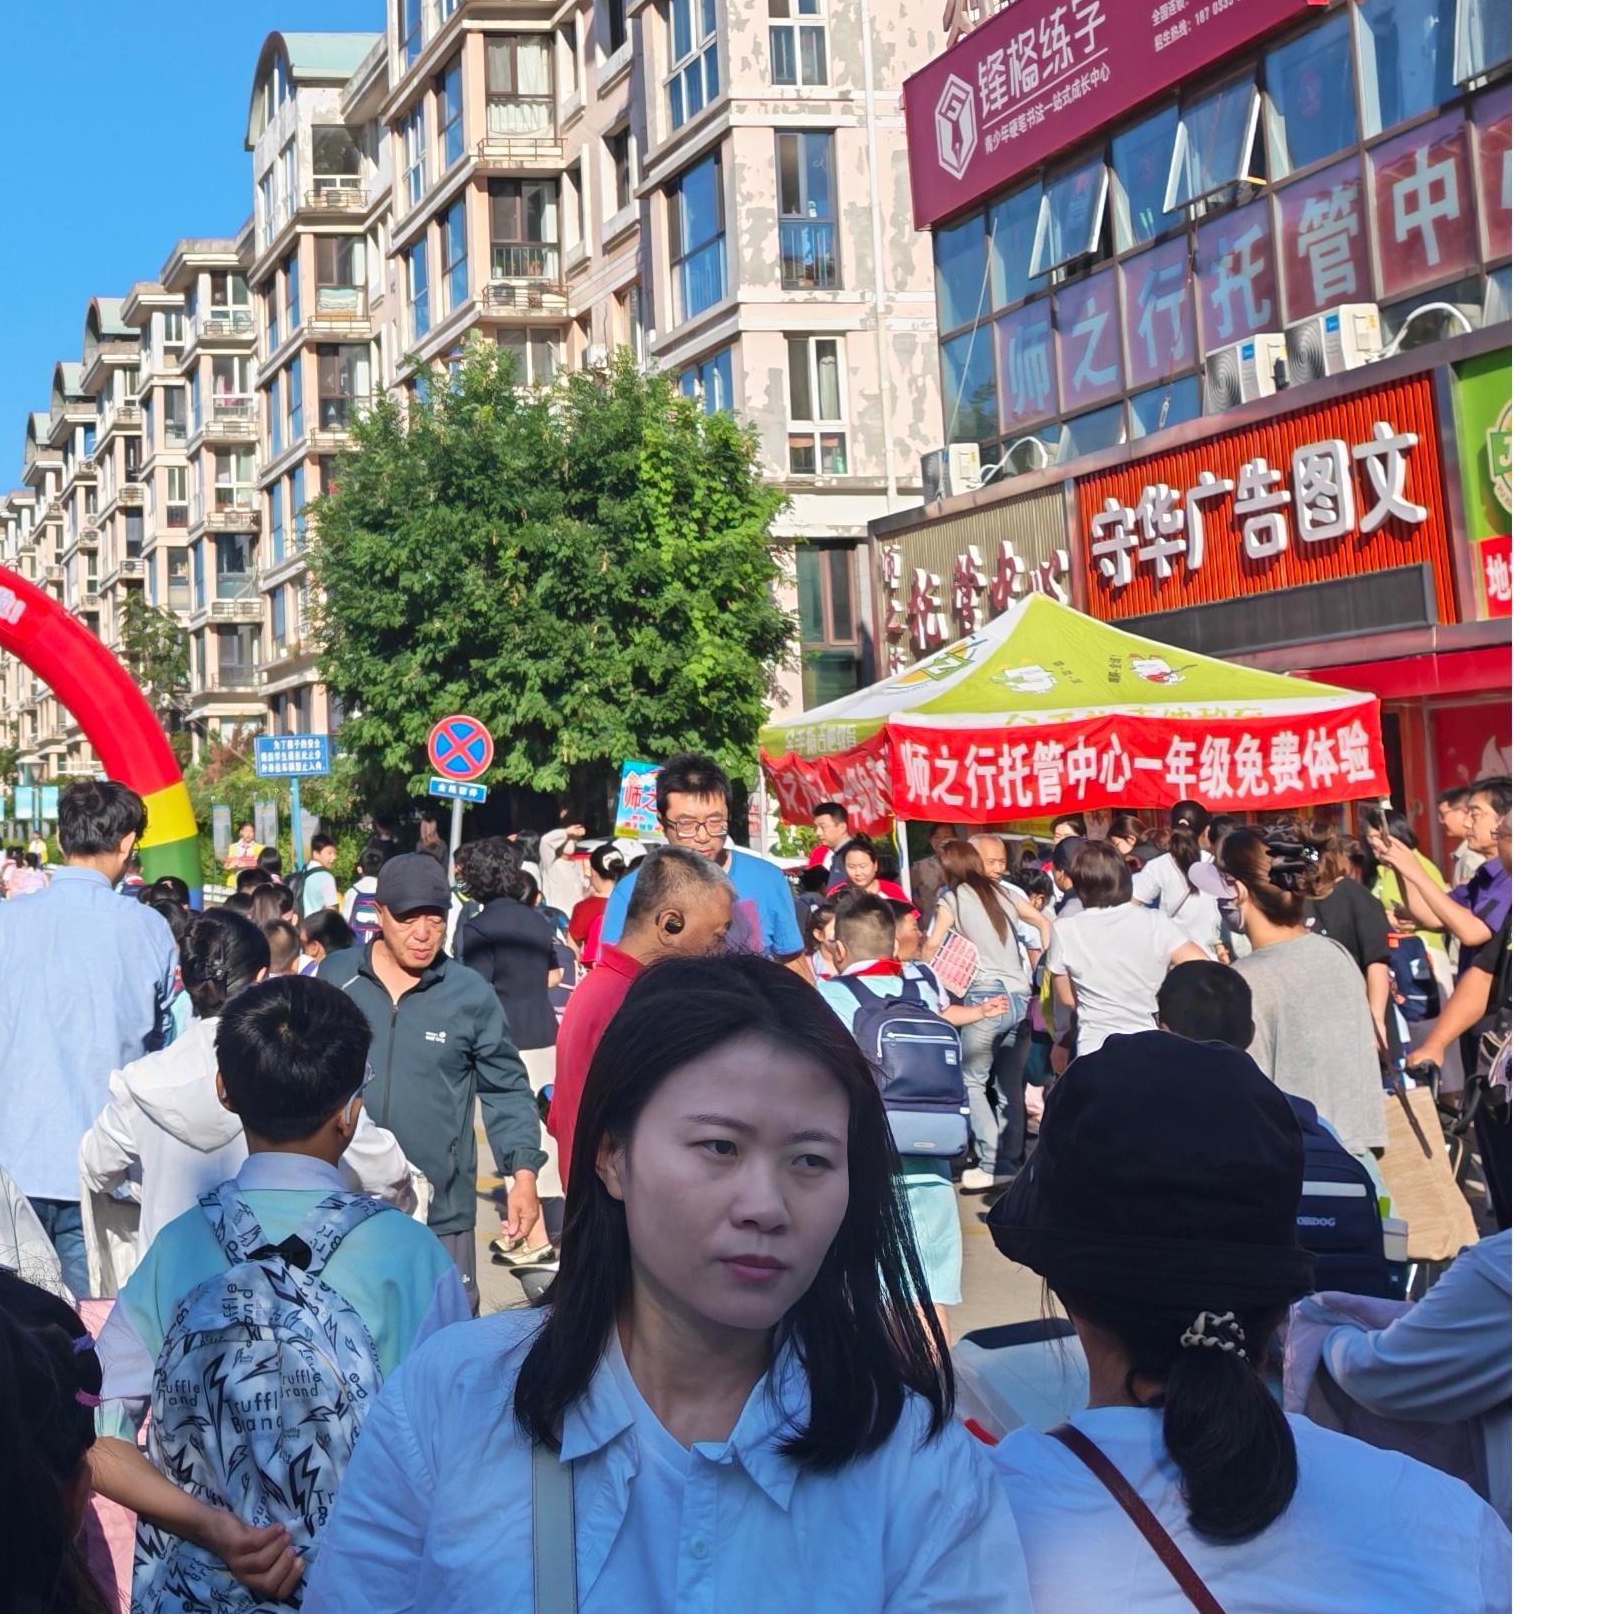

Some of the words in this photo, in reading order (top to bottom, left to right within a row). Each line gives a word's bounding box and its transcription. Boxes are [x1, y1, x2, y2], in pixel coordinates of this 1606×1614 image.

[1008, 147, 1511, 417] 师之行托管中
[1091, 421, 1428, 588] 守华广告图文
[899, 719, 1376, 810] 师之行托管中心一年级免费体验
[225, 1391, 278, 1417] Truffl
[281, 1369, 322, 1385] ruffle
